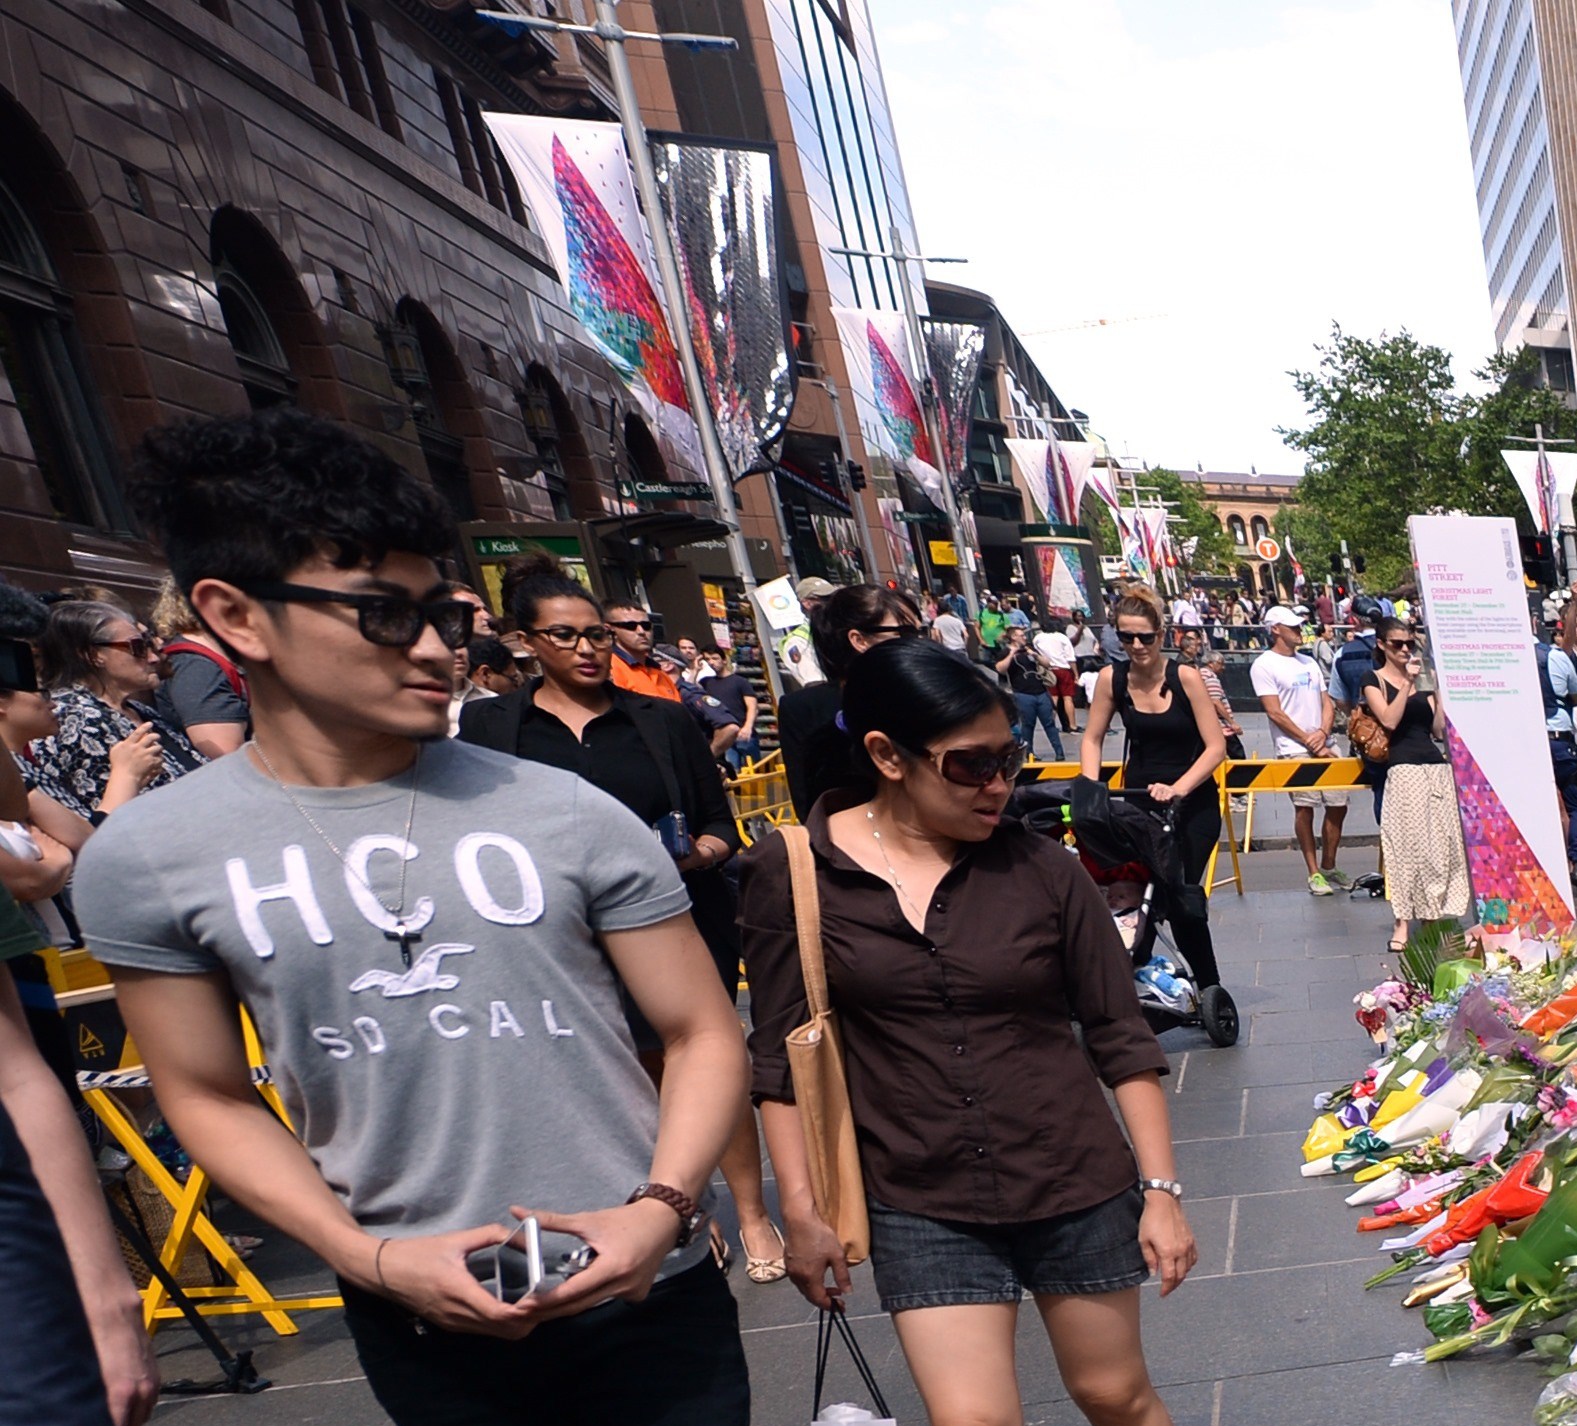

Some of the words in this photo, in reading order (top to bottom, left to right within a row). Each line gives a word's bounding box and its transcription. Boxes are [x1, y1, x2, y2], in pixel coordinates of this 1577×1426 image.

[636, 482, 697, 496] Castlereagh
[492, 542, 519, 553] Kiosk
[225, 831, 545, 959] HCO
[428, 1000, 575, 1040] CAL
